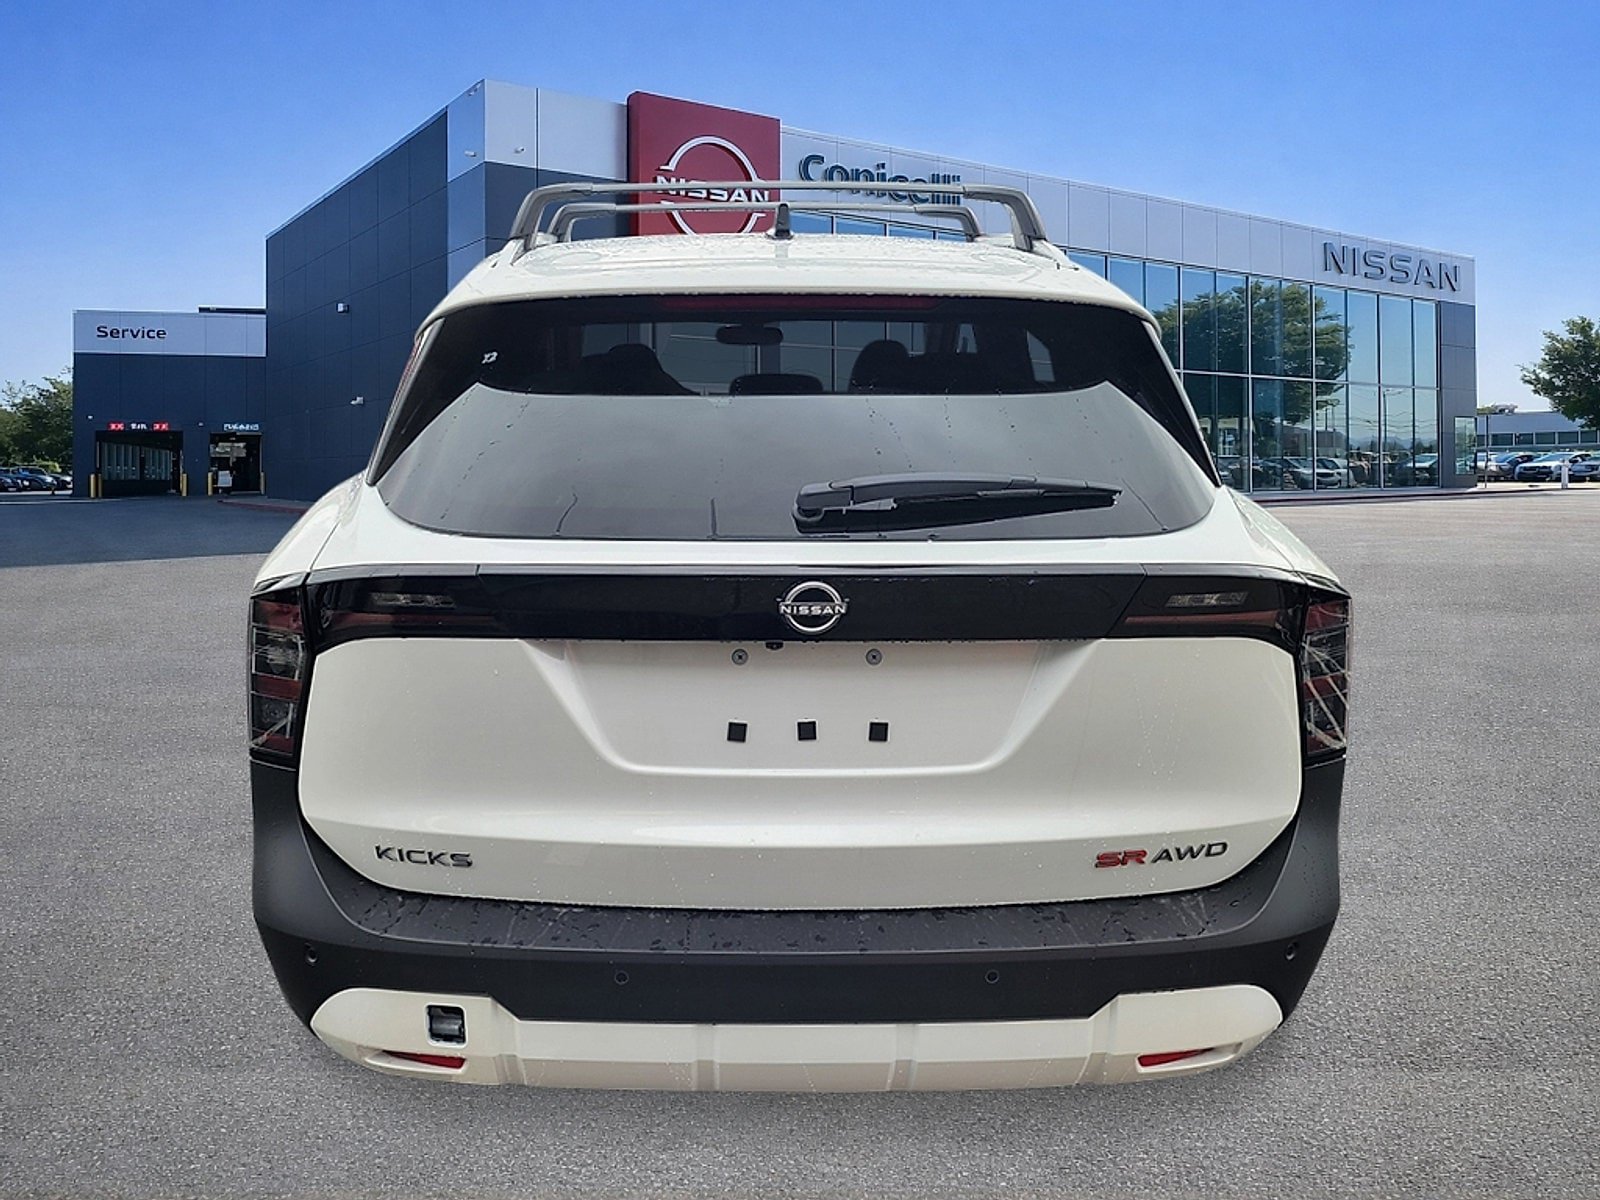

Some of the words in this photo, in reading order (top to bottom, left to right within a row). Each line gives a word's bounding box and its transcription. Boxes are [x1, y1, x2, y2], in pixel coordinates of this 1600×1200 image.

[656, 175, 769, 203] NISSAN
[1323, 242, 1461, 292] NISSAN
[96, 325, 167, 339] Service
[780, 604, 847, 616] NISSAN
[375, 845, 473, 868] KICKS
[1095, 849, 1148, 868] SR
[1150, 841, 1228, 864] AWD
